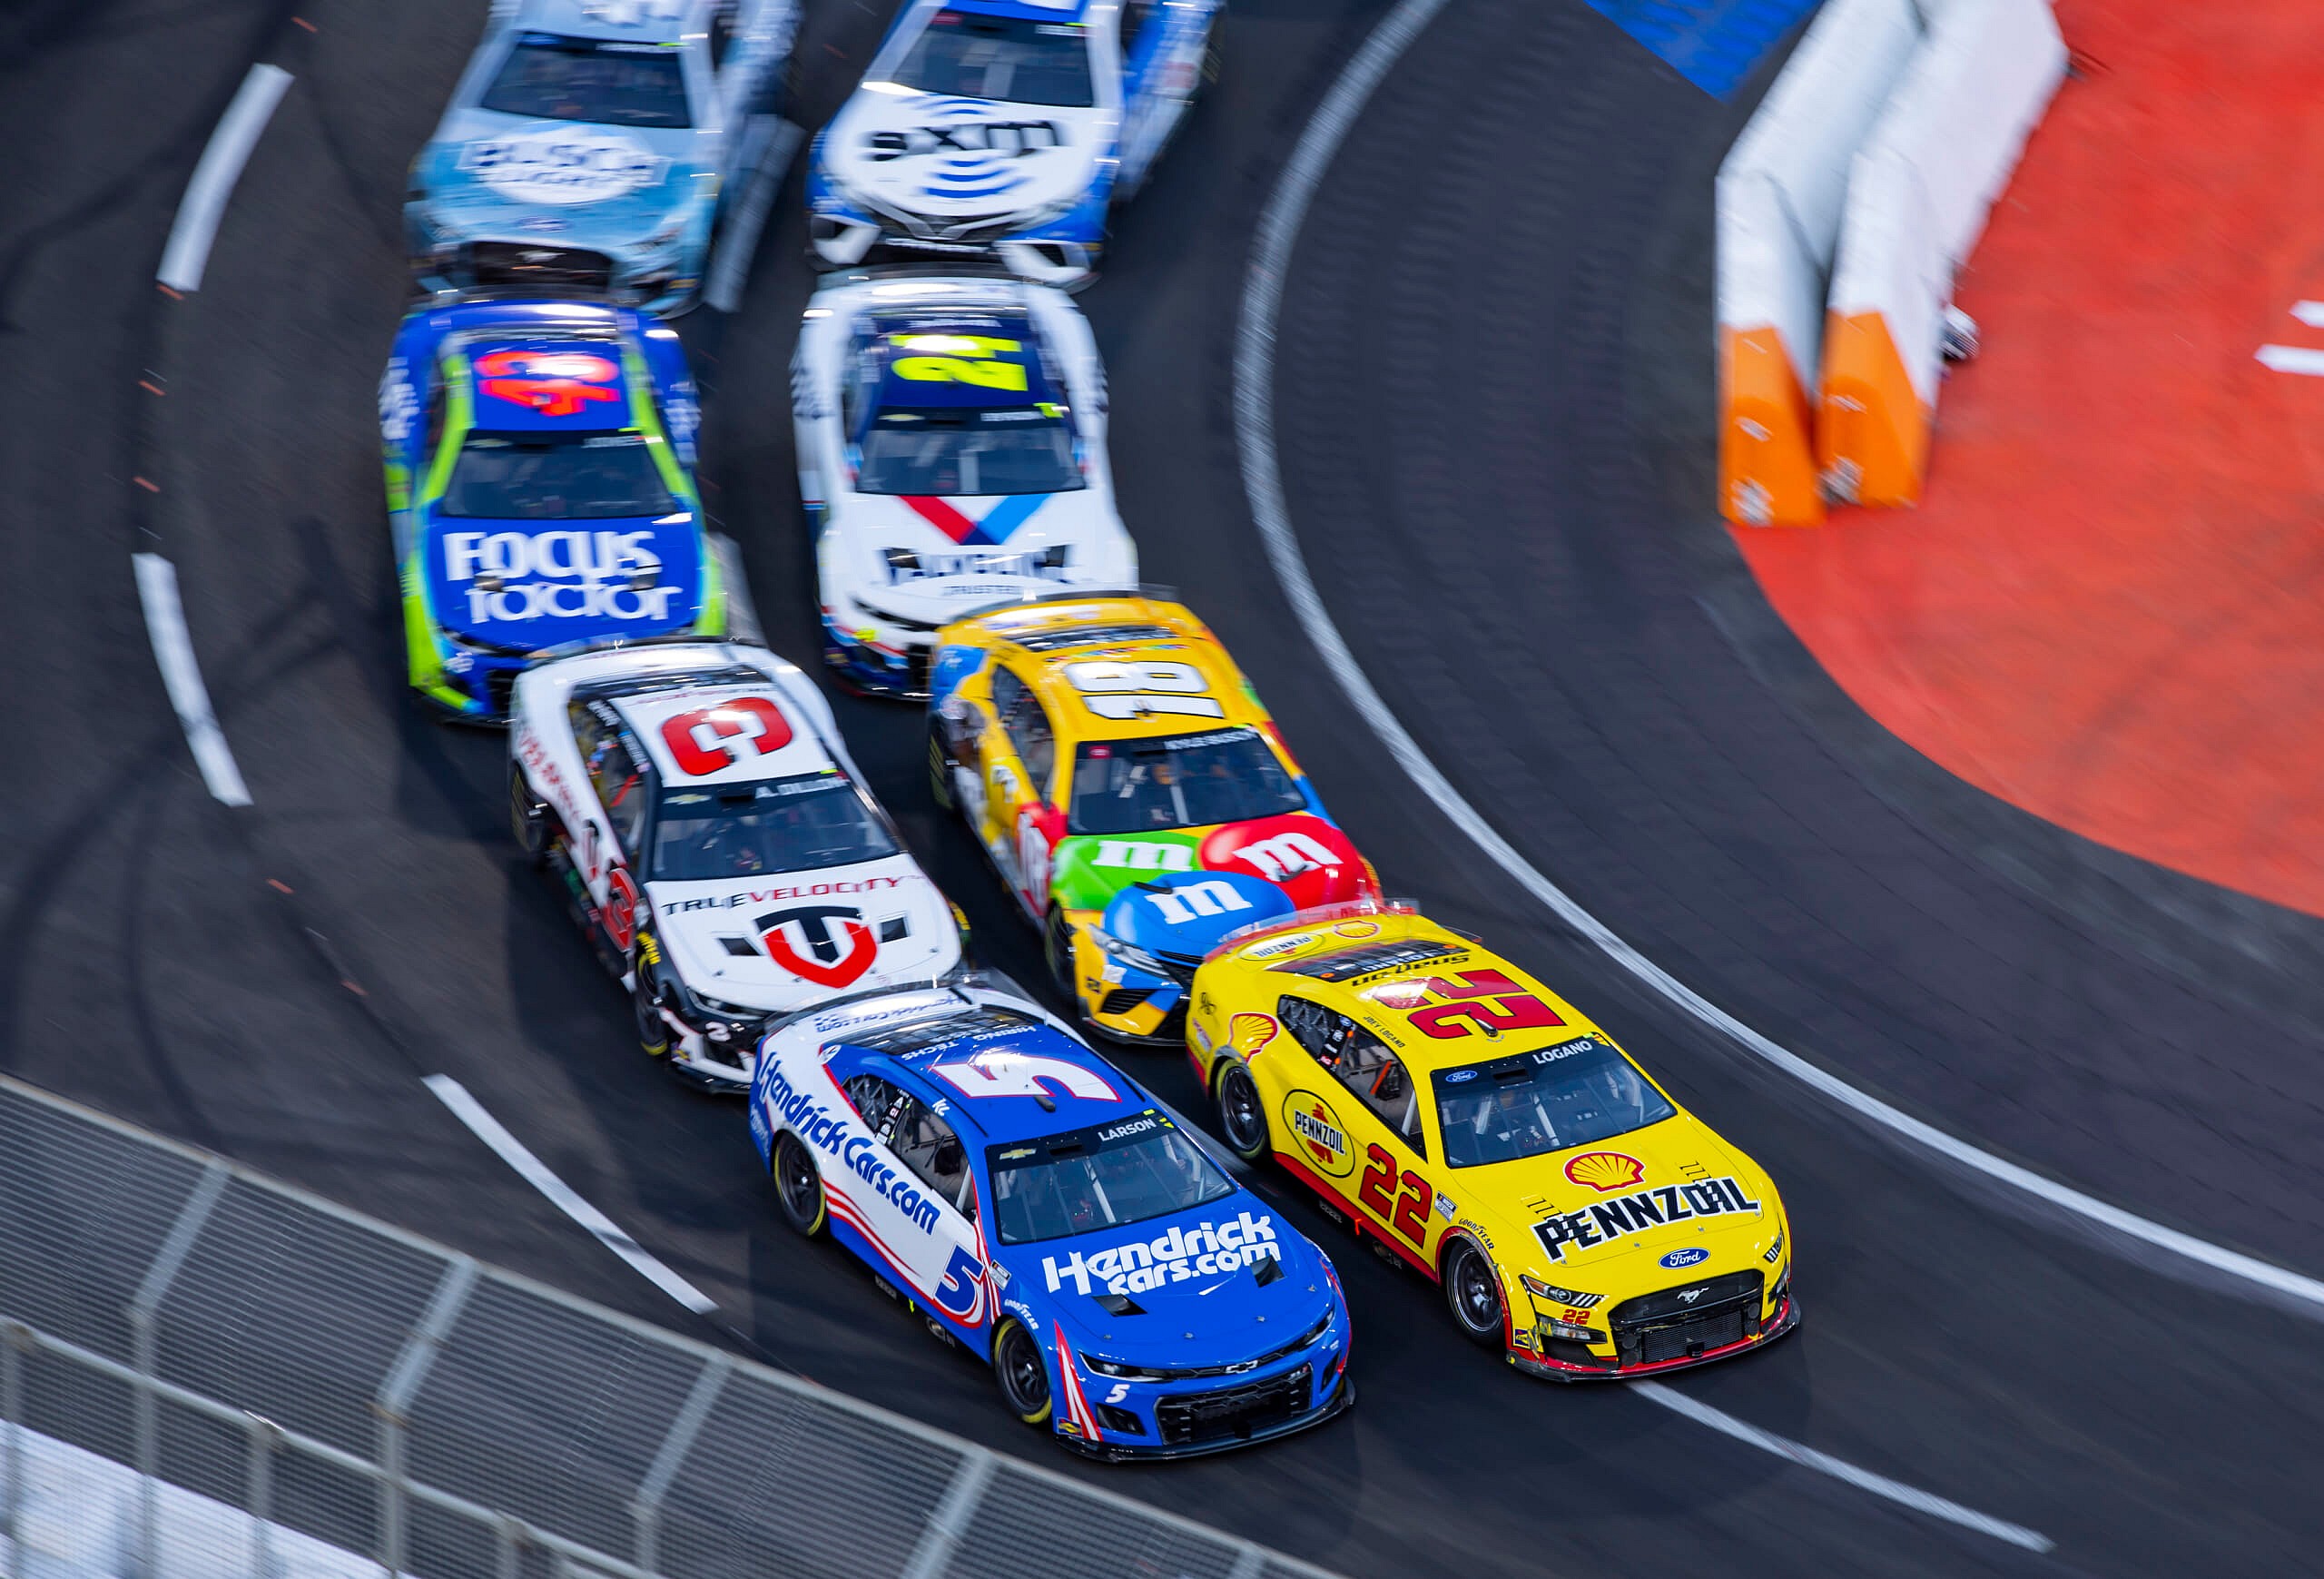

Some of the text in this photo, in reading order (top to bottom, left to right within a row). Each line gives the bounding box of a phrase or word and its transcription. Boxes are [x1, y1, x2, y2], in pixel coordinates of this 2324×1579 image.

[442, 531, 663, 581] FOCUS
[1063, 660, 1225, 720] 18
[1091, 840, 1192, 872] m
[1233, 833, 1344, 881] m
[1145, 881, 1253, 924] m
[1372, 968, 1568, 1039] 22
[926, 1051, 1122, 1102] 5
[1533, 1041, 1593, 1065] LOGANO
[1098, 1119, 1157, 1141] LARSON
[1295, 1109, 1346, 1156] PENNZOIL
[1359, 1142, 1433, 1249] 22
[1530, 1176, 1763, 1263] PENNZOIL
[1042, 1212, 1276, 1296] Hendrick
[1108, 1241, 1282, 1296] cars.com
[1668, 1249, 1702, 1267] Ford
[934, 1245, 985, 1321] 5
[1562, 1308, 1590, 1325] 22
[1105, 1384, 1130, 1404] 5
